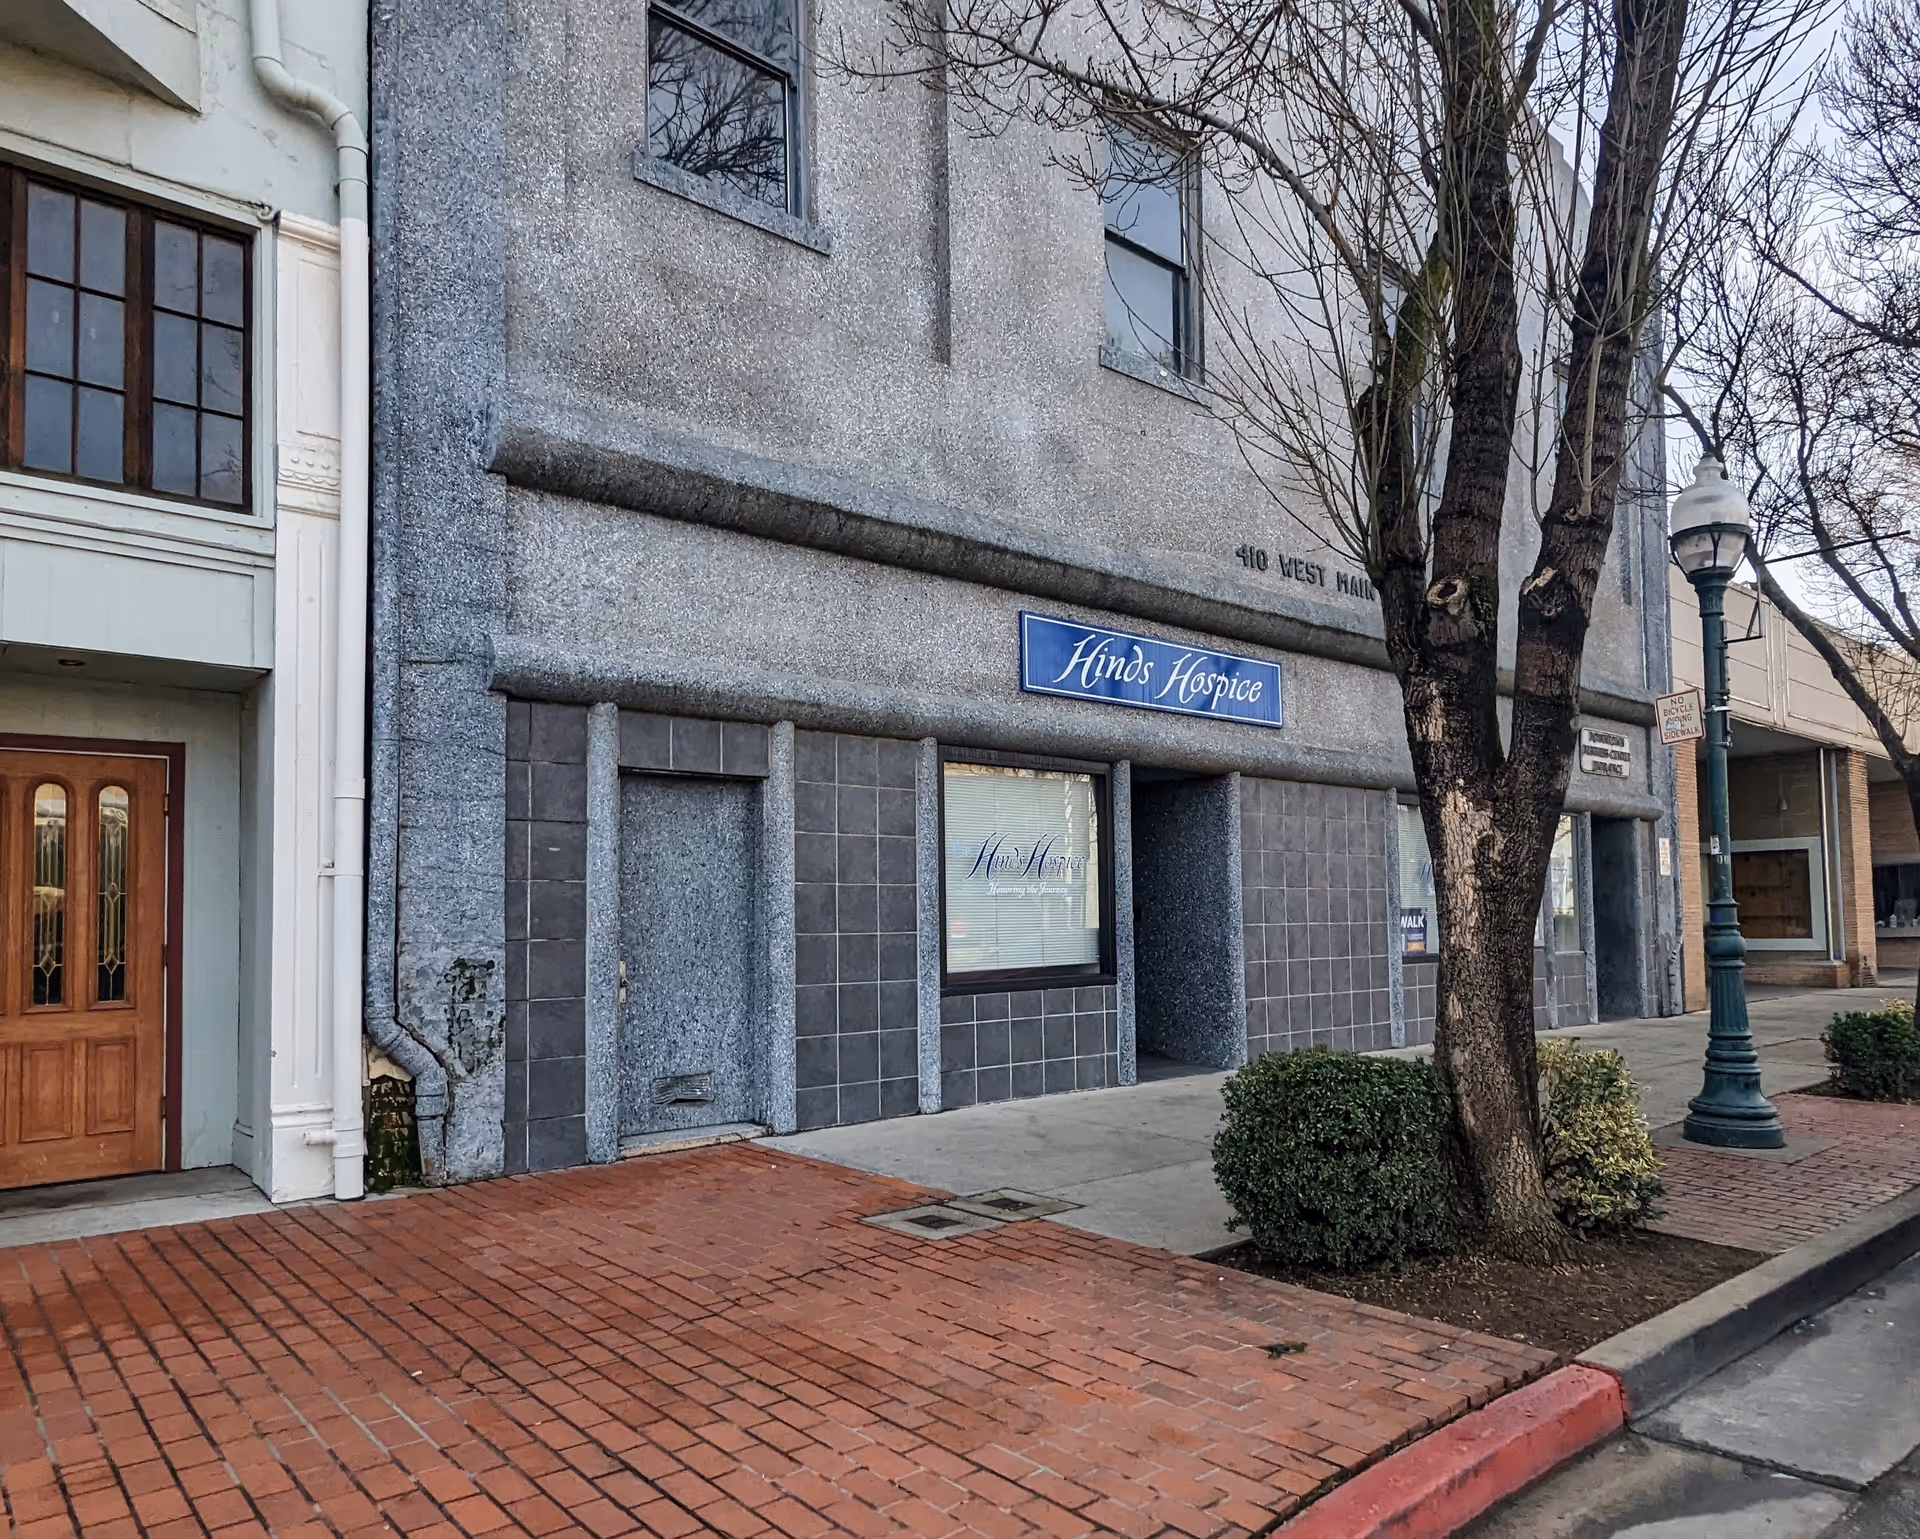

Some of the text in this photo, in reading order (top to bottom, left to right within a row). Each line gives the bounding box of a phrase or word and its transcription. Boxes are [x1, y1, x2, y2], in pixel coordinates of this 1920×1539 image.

[1236, 544, 1376, 601] 410 WEST MAIN
[1053, 634, 1263, 710] Hinds Hospice
[1670, 696, 1684, 705] NO
[1663, 703, 1694, 717] BICYCLE
[1664, 726, 1701, 740] SIDEWALK
[1018, 833, 1086, 881] Hospice
[986, 882, 1069, 898] Honoring the Journey
[1401, 915, 1425, 929] WALK
